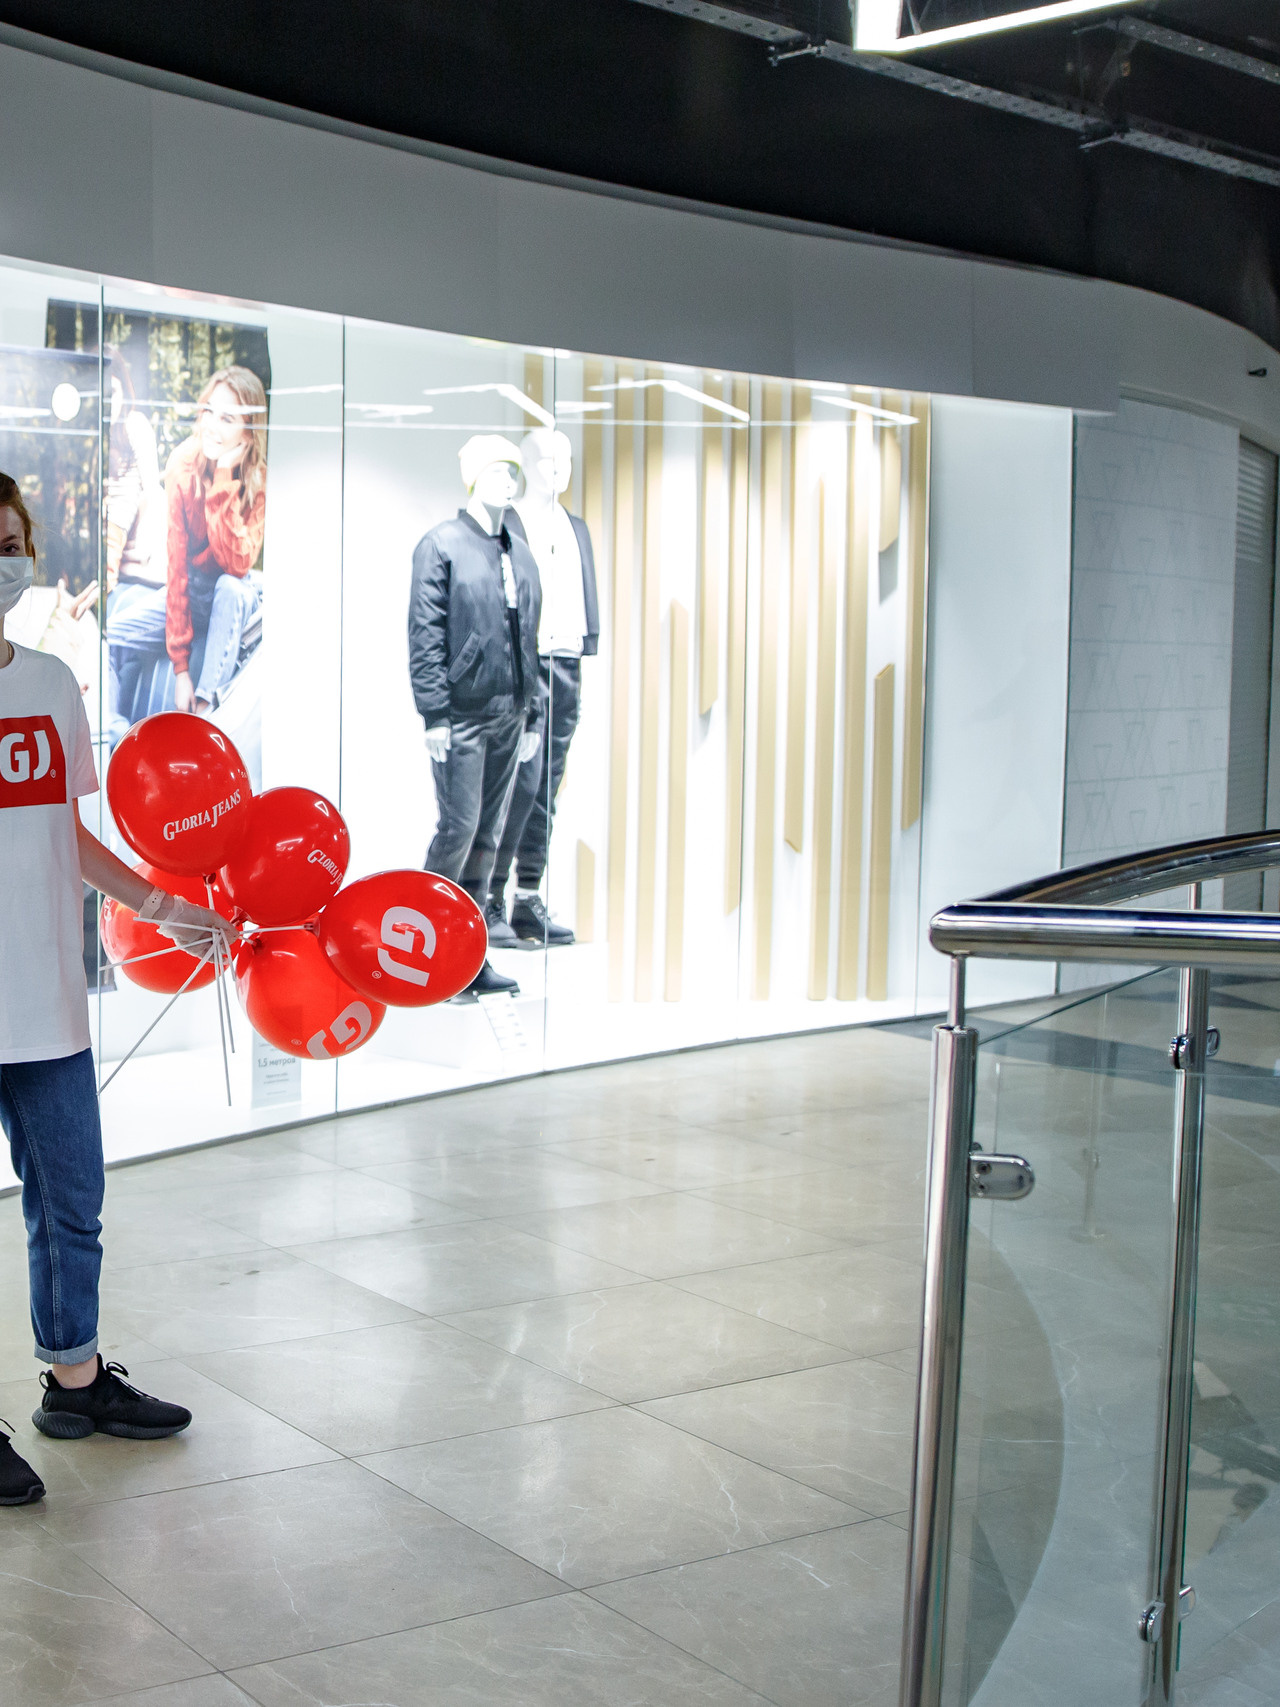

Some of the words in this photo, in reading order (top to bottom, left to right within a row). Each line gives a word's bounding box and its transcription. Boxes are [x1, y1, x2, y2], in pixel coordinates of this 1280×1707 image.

[163, 809, 211, 841] GLORIA
[210, 788, 241, 828] JEANS
[307, 849, 340, 878] GLORIA
[376, 905, 437, 988] GJ
